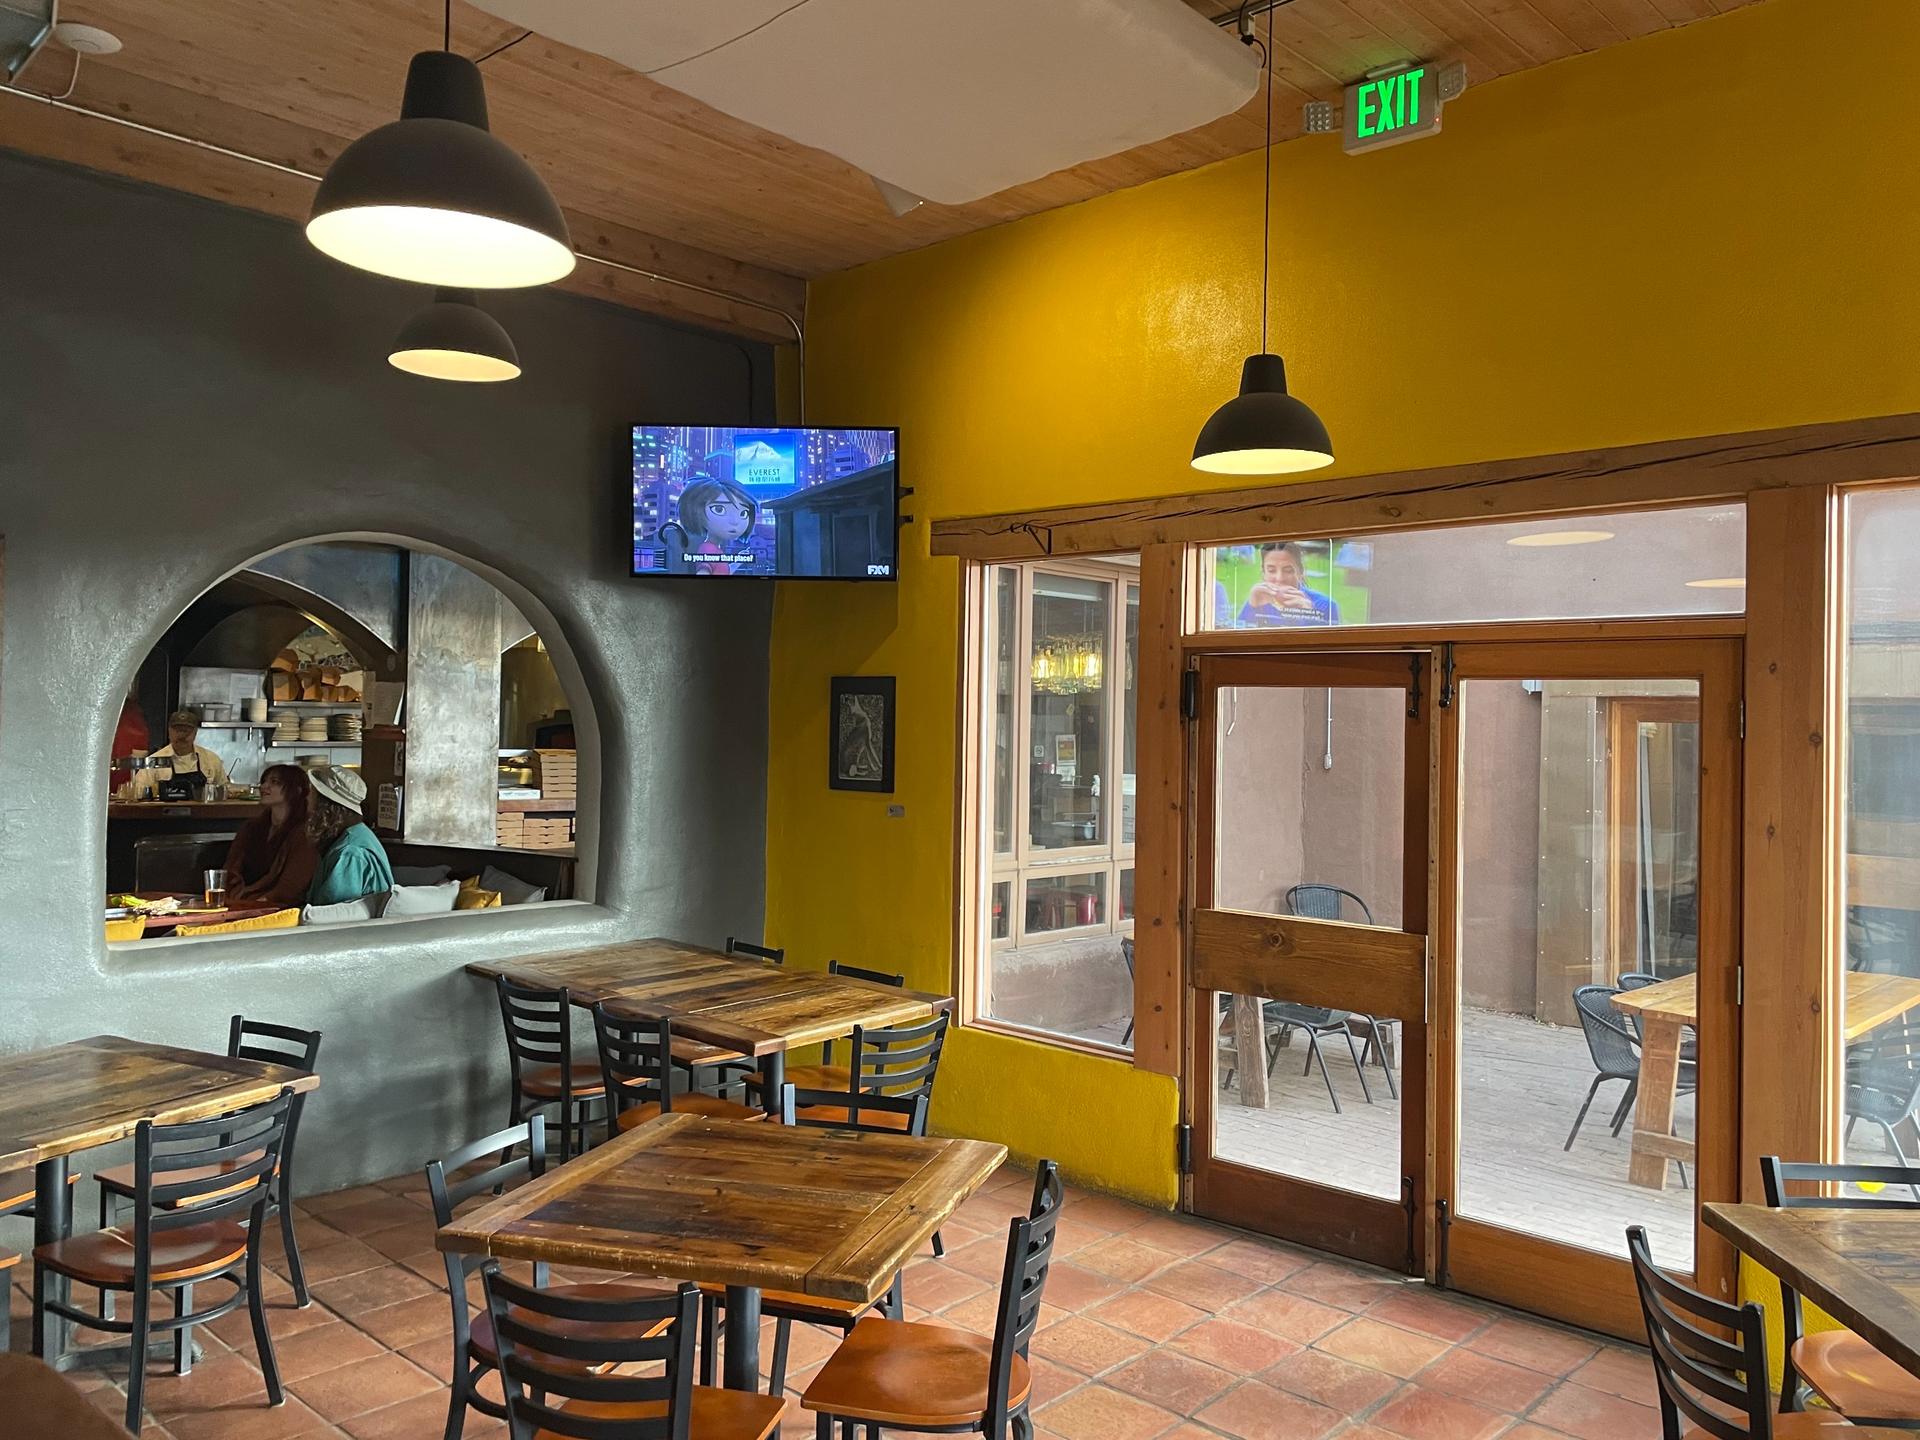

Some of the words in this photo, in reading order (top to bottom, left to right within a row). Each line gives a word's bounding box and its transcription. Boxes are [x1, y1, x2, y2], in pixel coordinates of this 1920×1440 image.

[1358, 68, 1424, 138] EXIT
[749, 468, 780, 476] EVEREST
[684, 553, 692, 561] Do
[692, 554, 704, 562] you
[704, 553, 720, 561] know
[734, 554, 753, 562] place?
[868, 565, 889, 575] FXM
